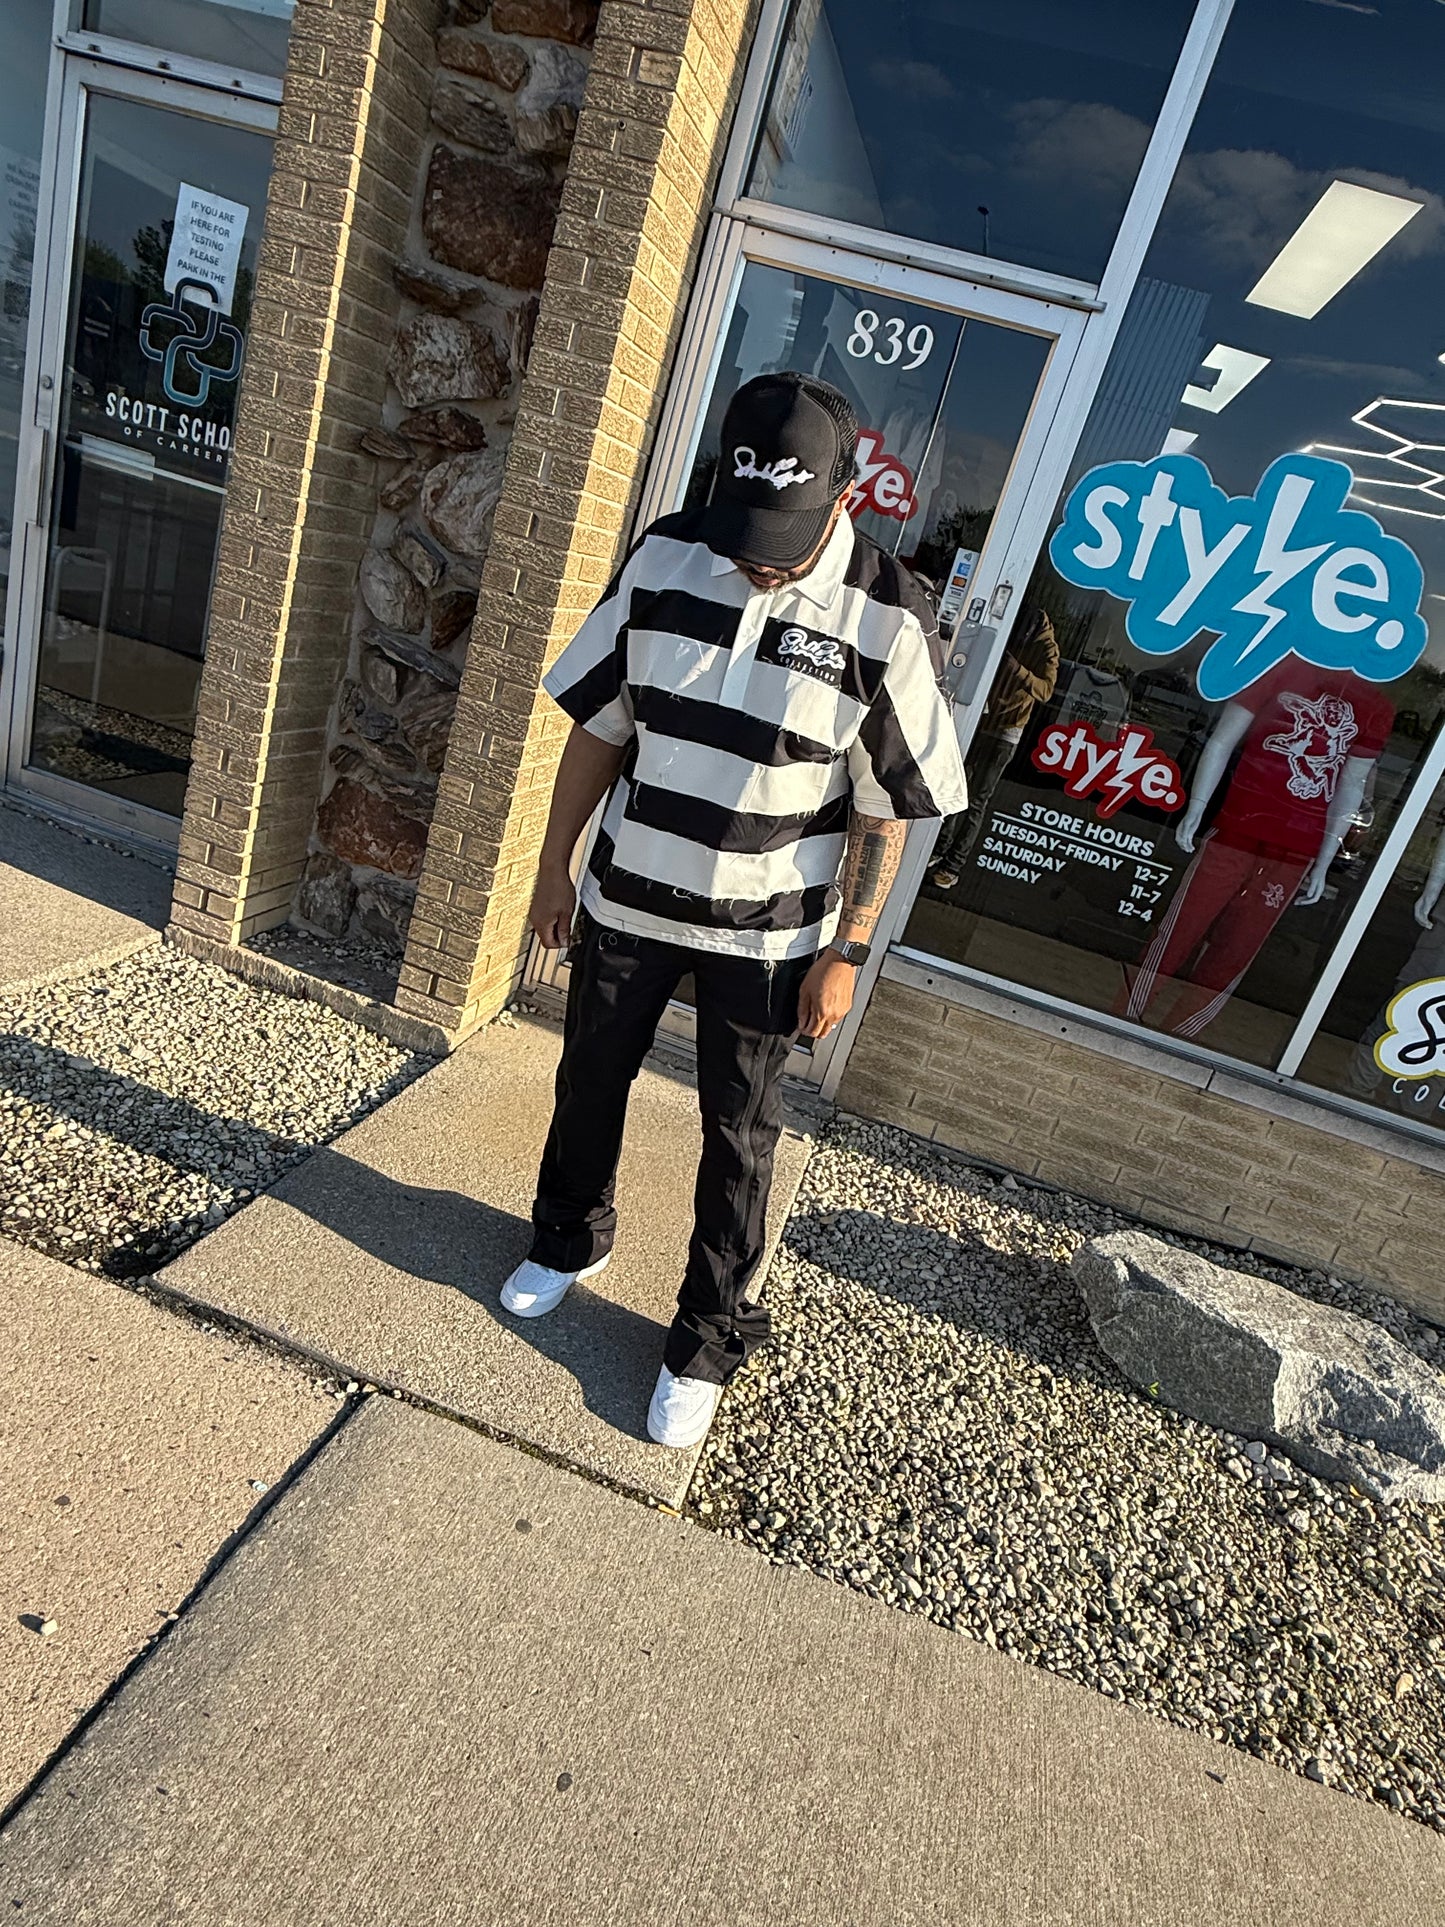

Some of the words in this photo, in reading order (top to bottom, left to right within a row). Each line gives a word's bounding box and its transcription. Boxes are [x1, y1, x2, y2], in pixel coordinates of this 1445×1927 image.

[190, 216, 212, 231] HERE
[213, 225, 230, 238] FOR
[191, 200, 199, 209] IF
[201, 203, 218, 217] YOU
[219, 211, 235, 224] ARE
[189, 248, 220, 266] PLEASE
[191, 232, 224, 252] TESTING
[177, 259, 198, 273] PARK
[199, 268, 209, 278] IN
[210, 271, 226, 284] THE
[846, 309, 935, 371] 839
[105, 392, 169, 433] SCOTT
[177, 413, 231, 451] SCHO
[123, 426, 143, 439] OF
[1020, 802, 1085, 835] STORE
[1085, 825, 1156, 857] HOURS
[983, 837, 1067, 874] SATURDAY
[1130, 884, 1162, 905] 11-7
[991, 818, 1124, 872] TUESDAY-FRIDAY
[1134, 865, 1170, 888] 12-7
[976, 854, 1042, 885] SUNDAY
[1117, 900, 1153, 923] 12-4
